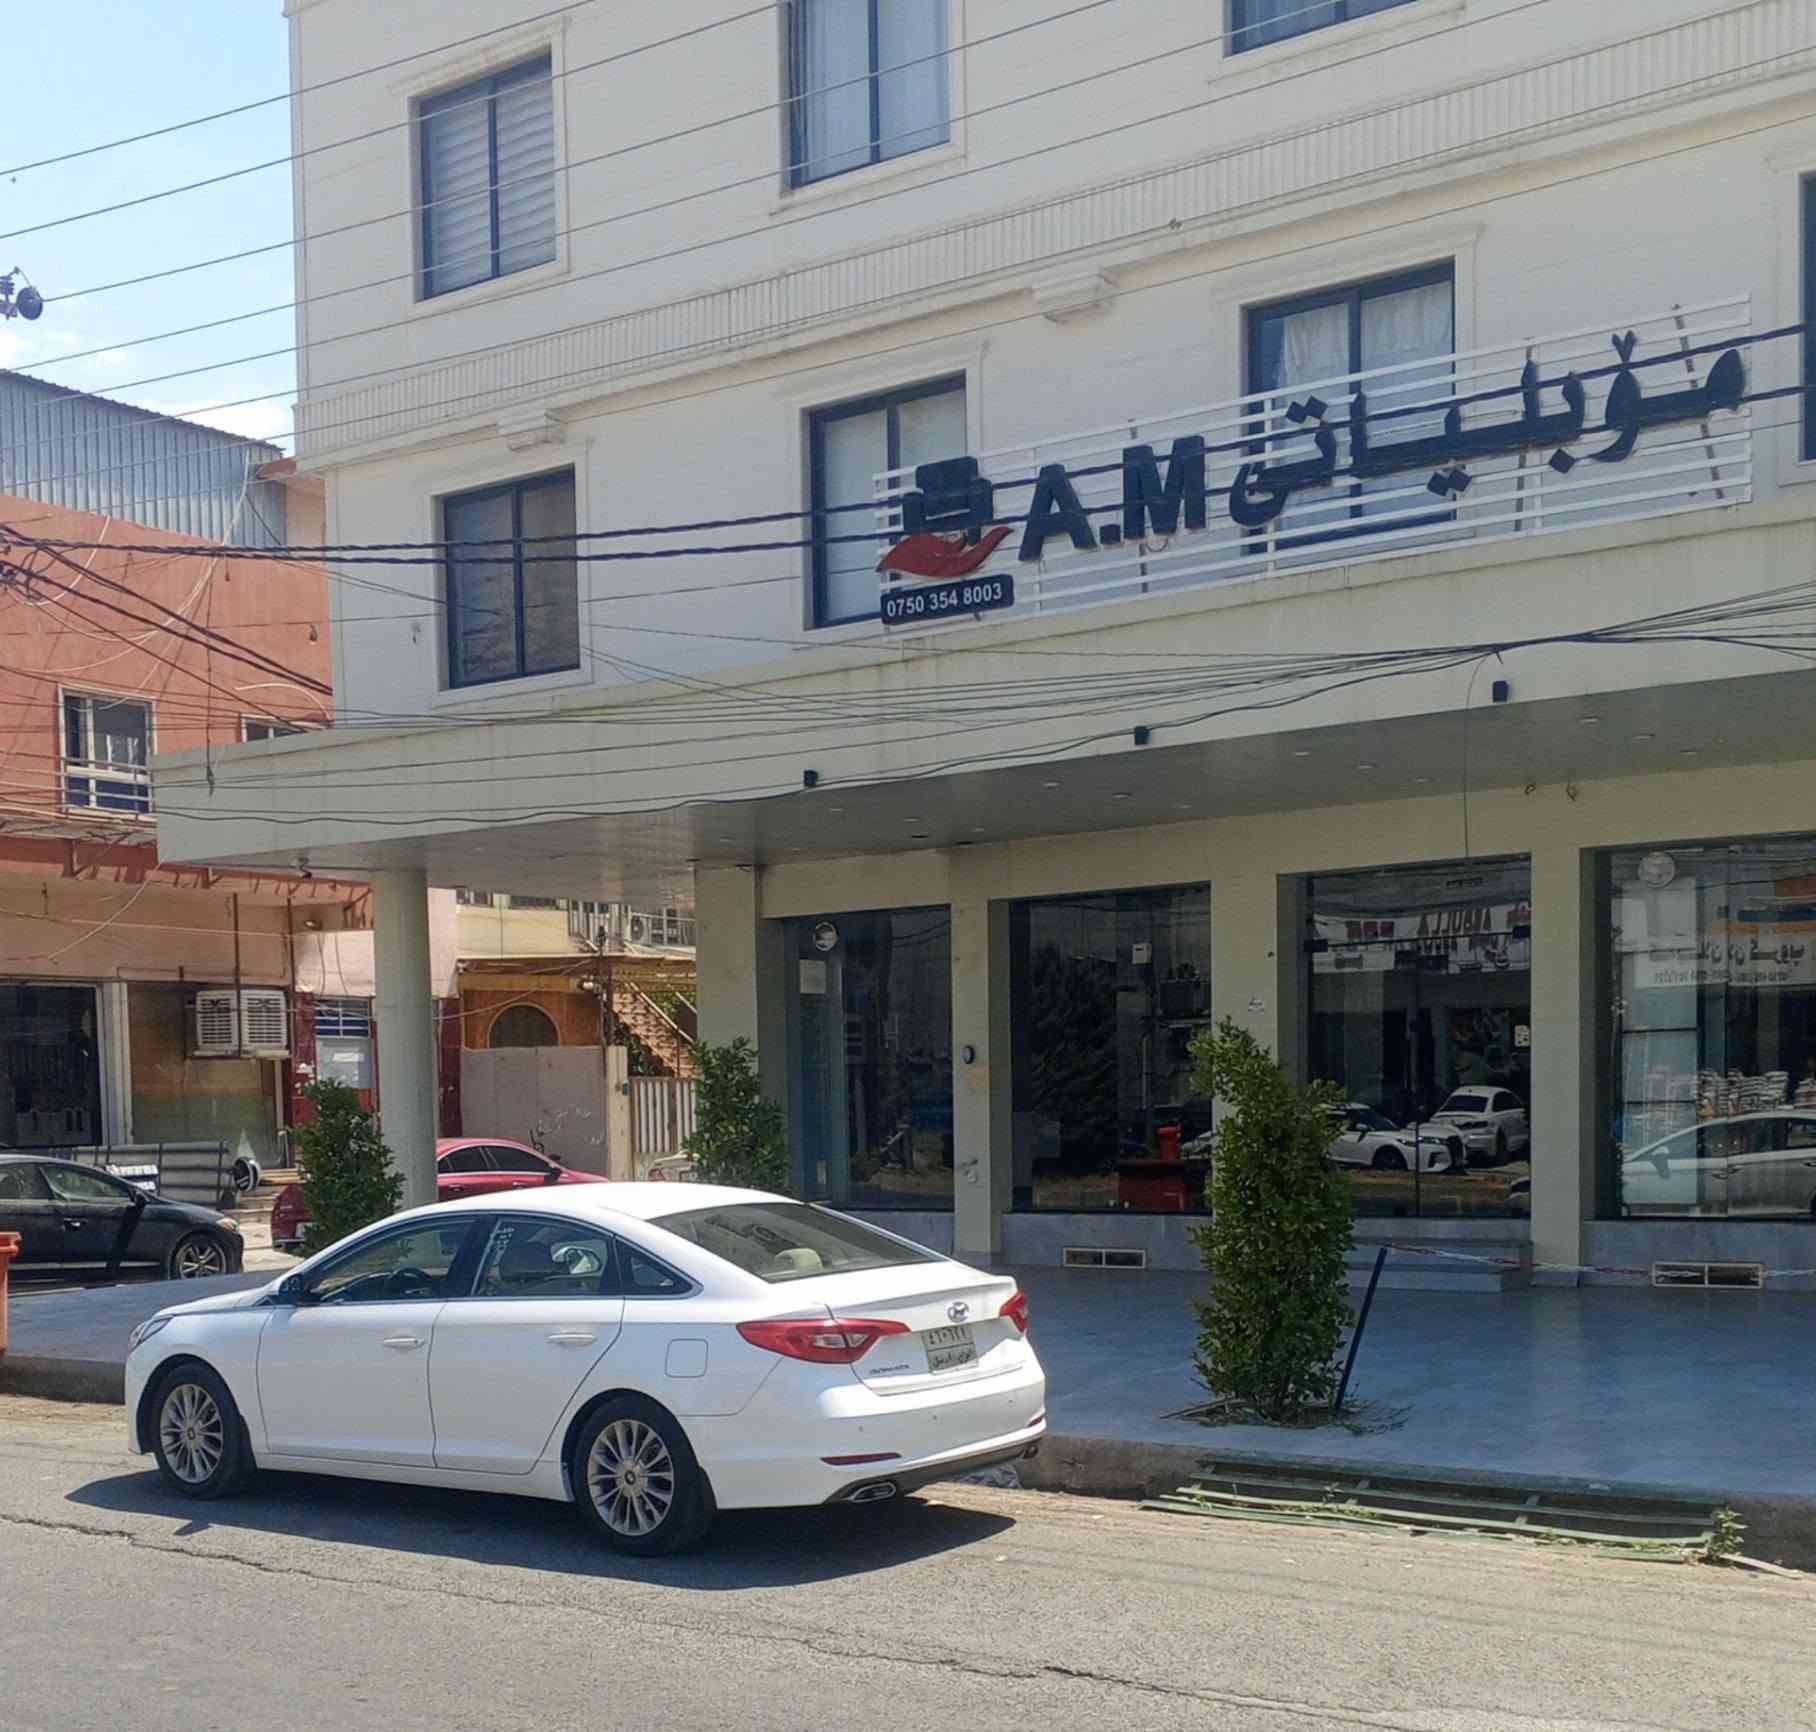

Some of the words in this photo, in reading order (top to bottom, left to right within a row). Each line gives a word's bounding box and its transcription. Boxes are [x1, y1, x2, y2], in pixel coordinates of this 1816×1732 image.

[1018, 435, 1206, 562] A.M
[886, 595, 925, 617] 0750
[929, 588, 959, 610] 354
[963, 582, 1002, 605] 8003
